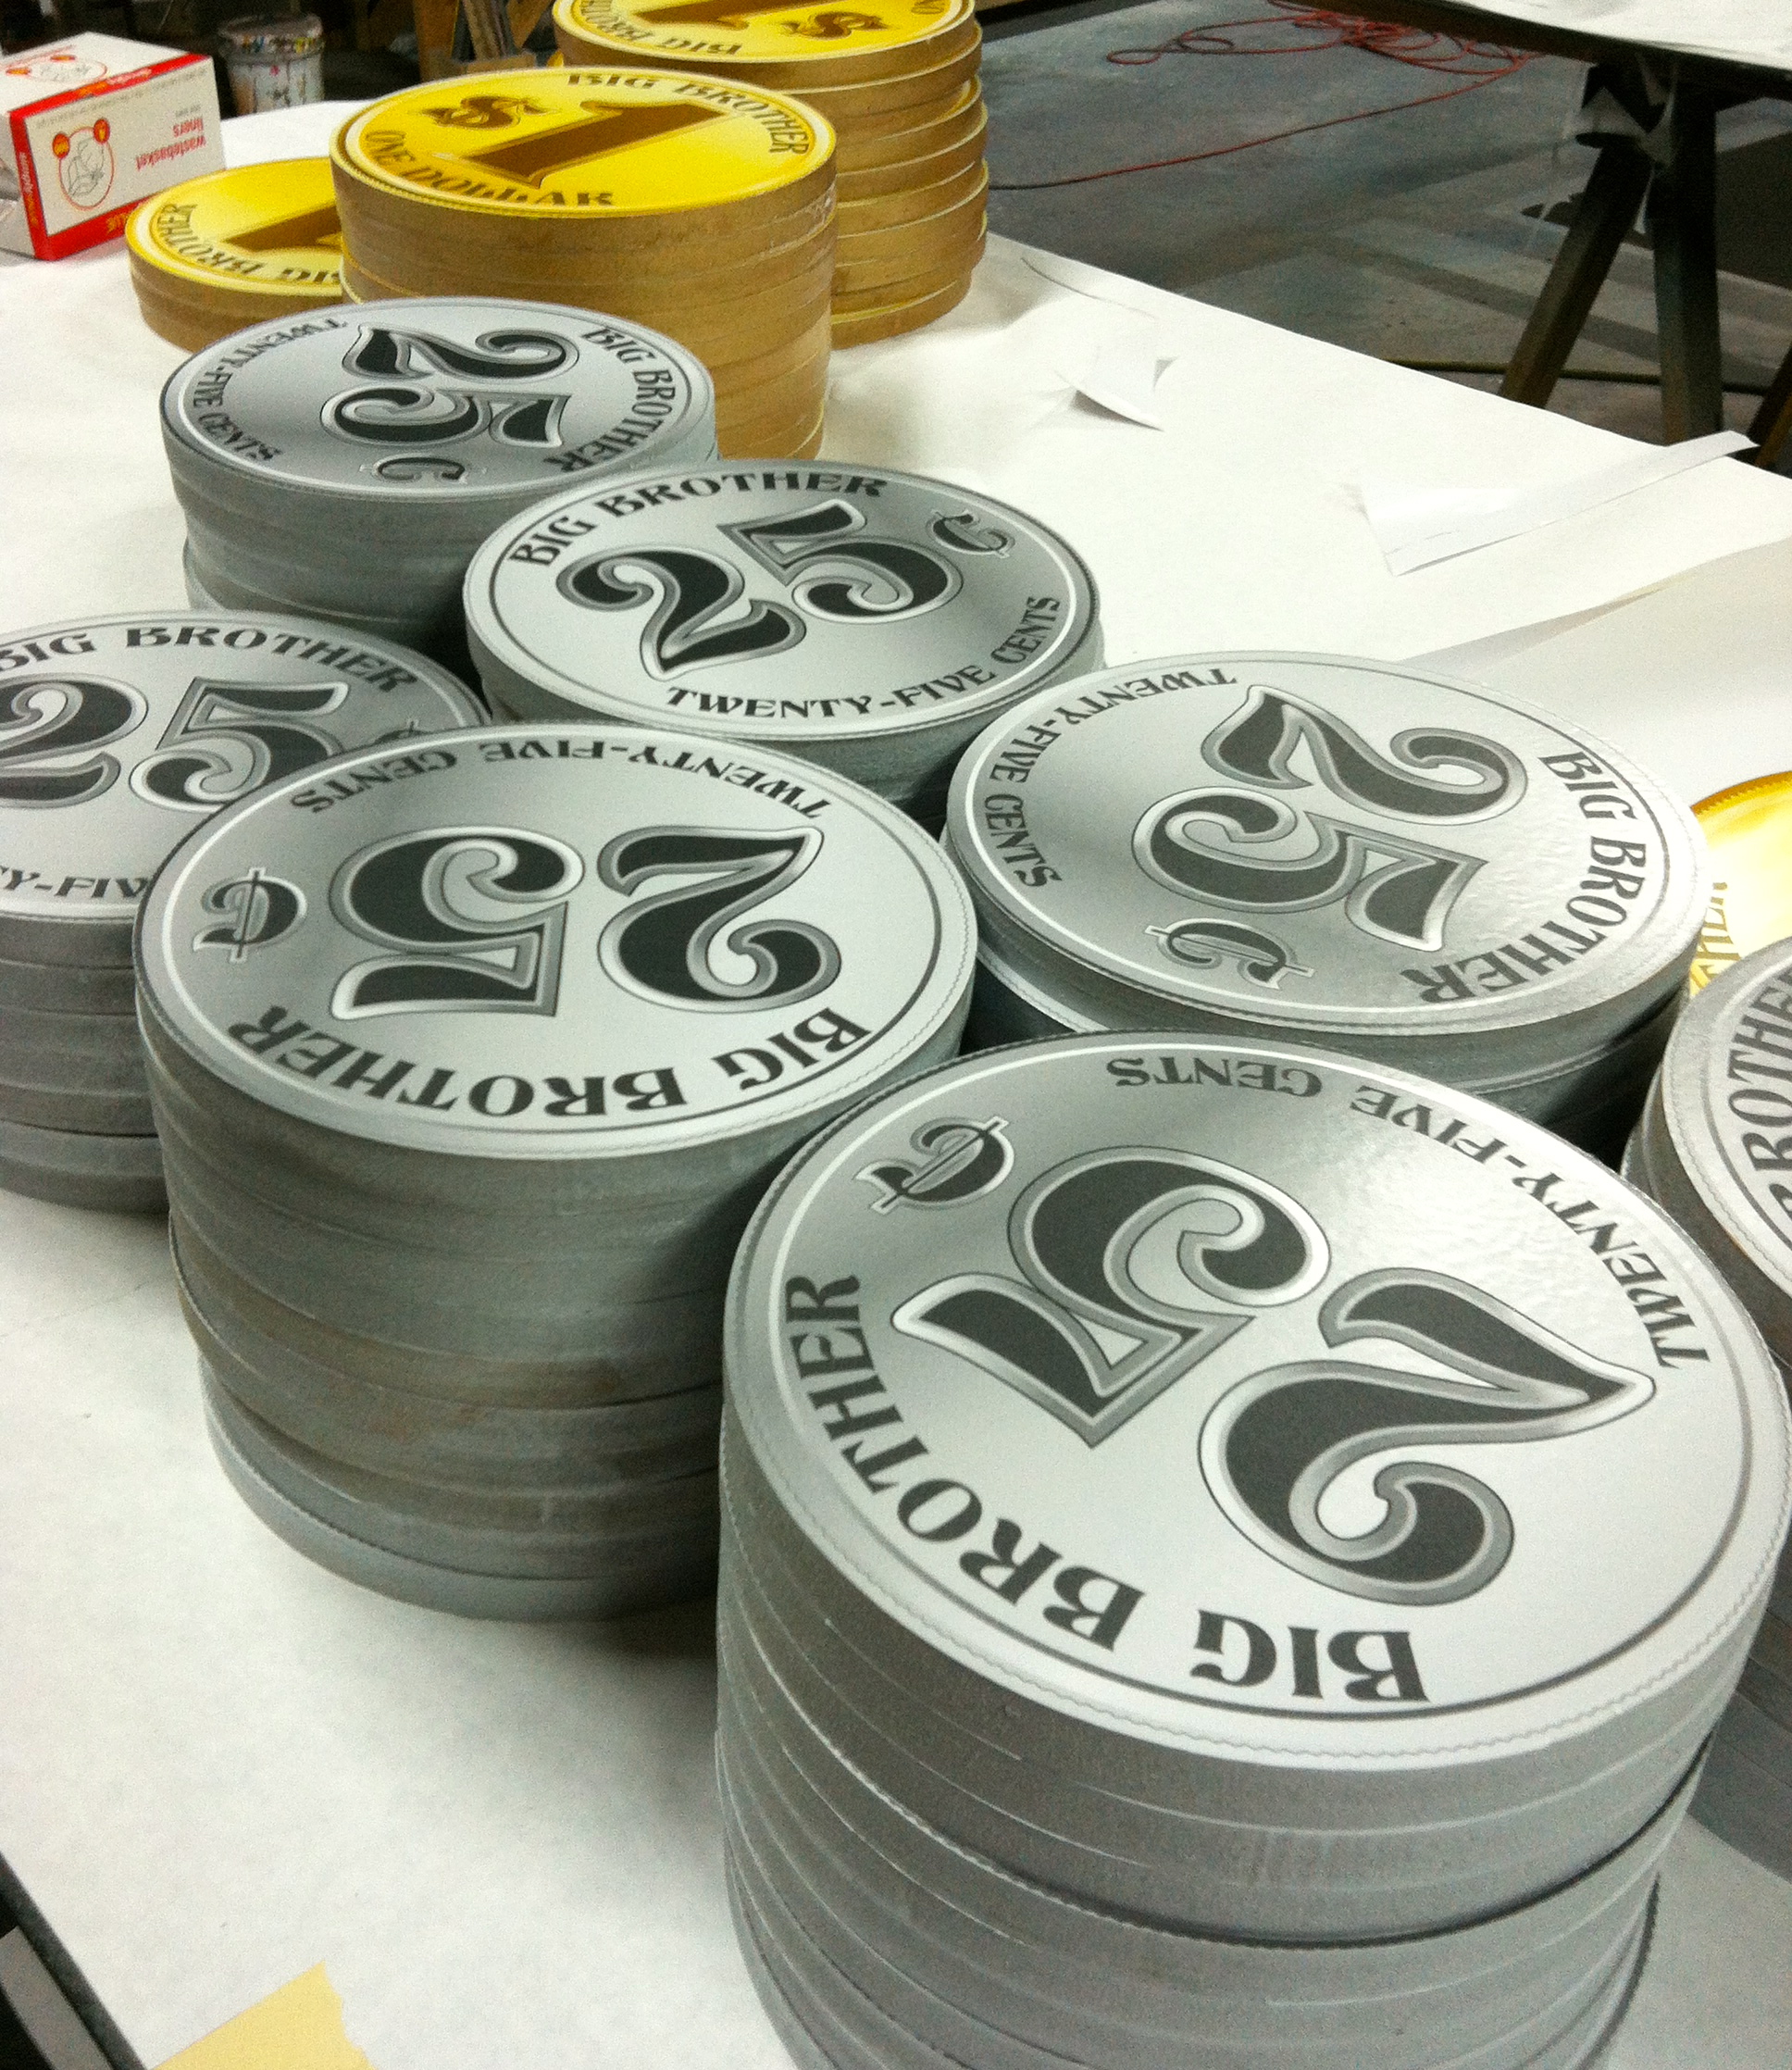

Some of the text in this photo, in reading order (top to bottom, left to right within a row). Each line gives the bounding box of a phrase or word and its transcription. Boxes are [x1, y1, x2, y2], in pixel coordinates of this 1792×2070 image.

[661, 37, 743, 56] BIG
[136, 135, 206, 170] wastebasket
[173, 117, 204, 137] liners
[365, 131, 616, 206] ONE DOLLAR
[567, 73, 810, 155] BIG BROTHER
[157, 204, 268, 274] BROTHER
[193, 318, 348, 407] TWENTY-FIVE
[320, 324, 580, 448] 25
[541, 328, 678, 472] BIG BROTHER
[198, 413, 281, 460] CENTS
[509, 472, 888, 567] BIG BROTHER
[555, 499, 964, 681] 25
[0, 626, 418, 693] BIG BROTHER
[666, 595, 1061, 718] TWENTY-FIVE CENTS
[0, 672, 349, 813] 25
[290, 740, 831, 818] TWENTY-FIVE CENTS
[984, 668, 1238, 887] TWENTY-FIVE CENTS
[1131, 684, 1529, 953] 25
[1400, 751, 1648, 1004] BIG BROTHER
[329, 825, 841, 1019] 25
[229, 1004, 874, 1116] BIG BROTHER
[1727, 969, 1792, 1224] ROTHE
[1106, 1056, 1711, 1369] TWENTY-FIVE CENTS
[890, 1145, 1657, 1606] 25
[785, 1274, 1431, 1705] BIG BROTHER
